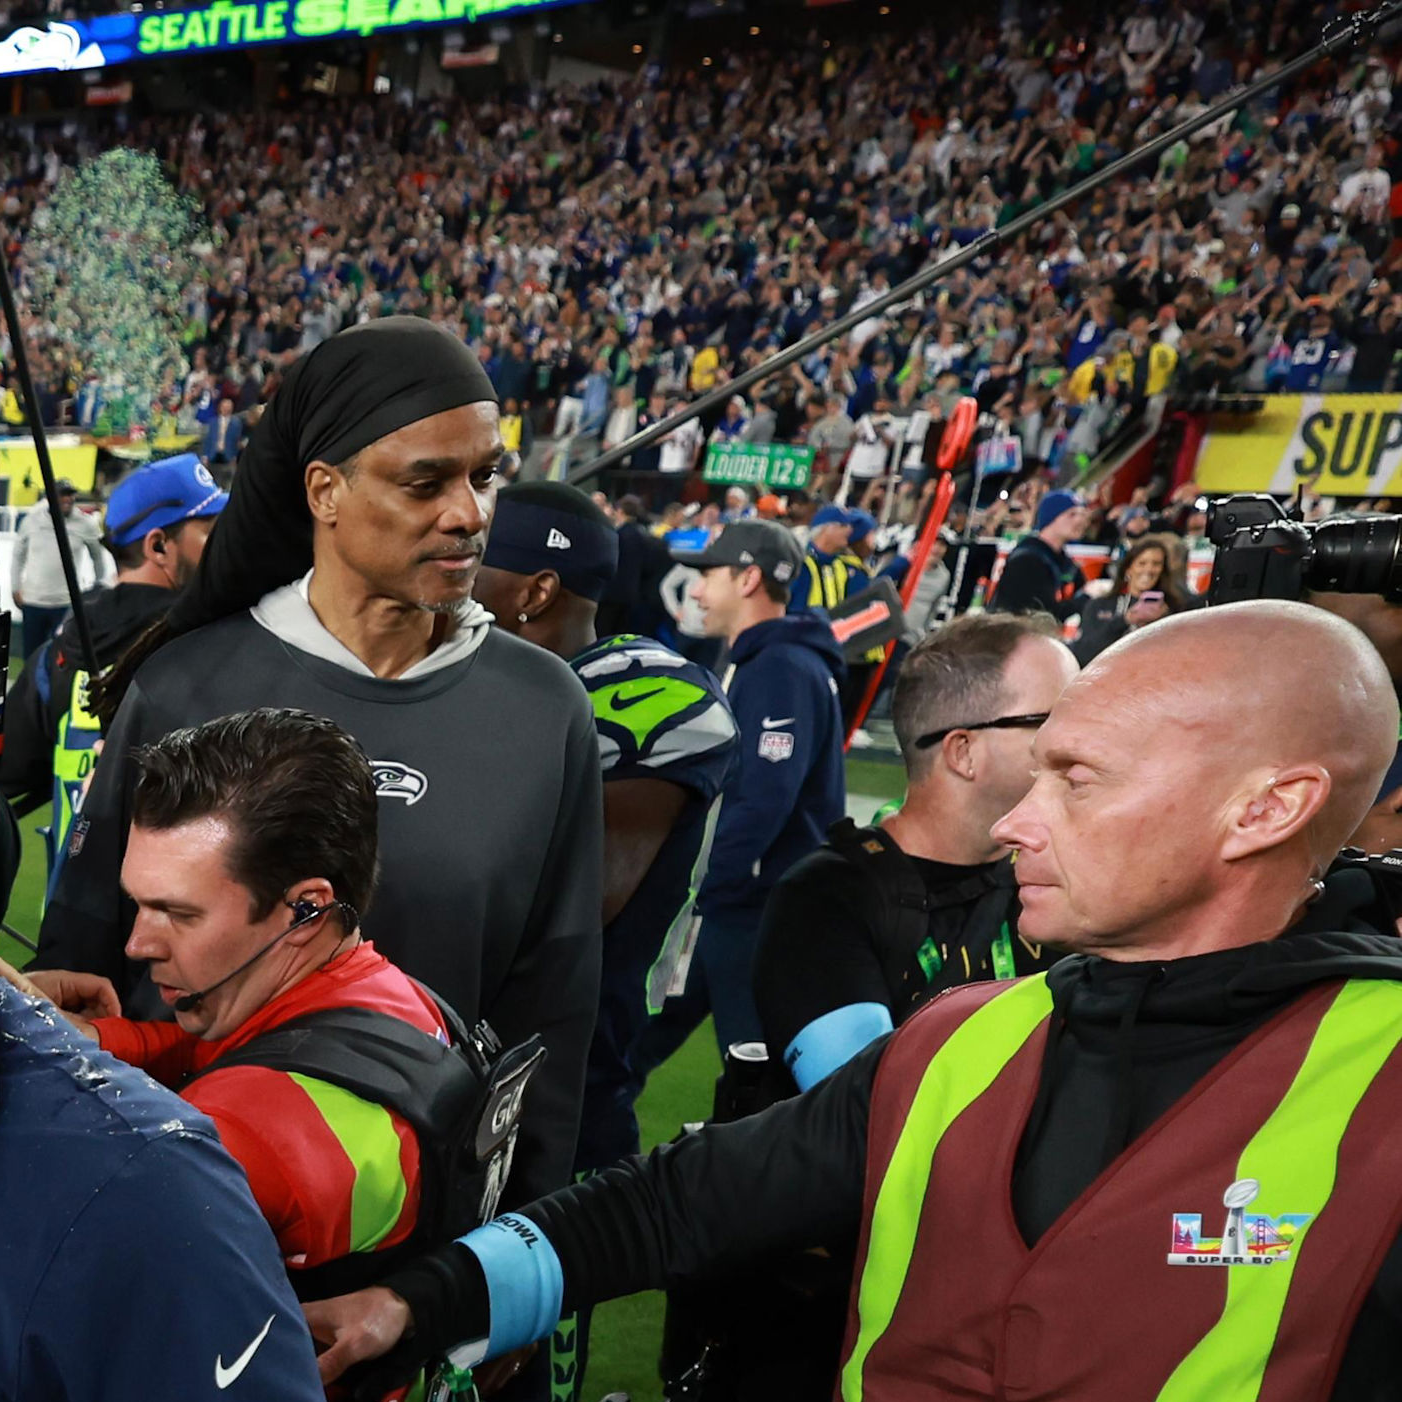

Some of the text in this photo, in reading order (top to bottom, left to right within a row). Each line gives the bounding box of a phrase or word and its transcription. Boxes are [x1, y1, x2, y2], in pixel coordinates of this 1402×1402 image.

[138, 1, 288, 54] SEATTLE
[703, 452, 770, 482] LOUDER
[1186, 1255, 1245, 1265] SUPER
